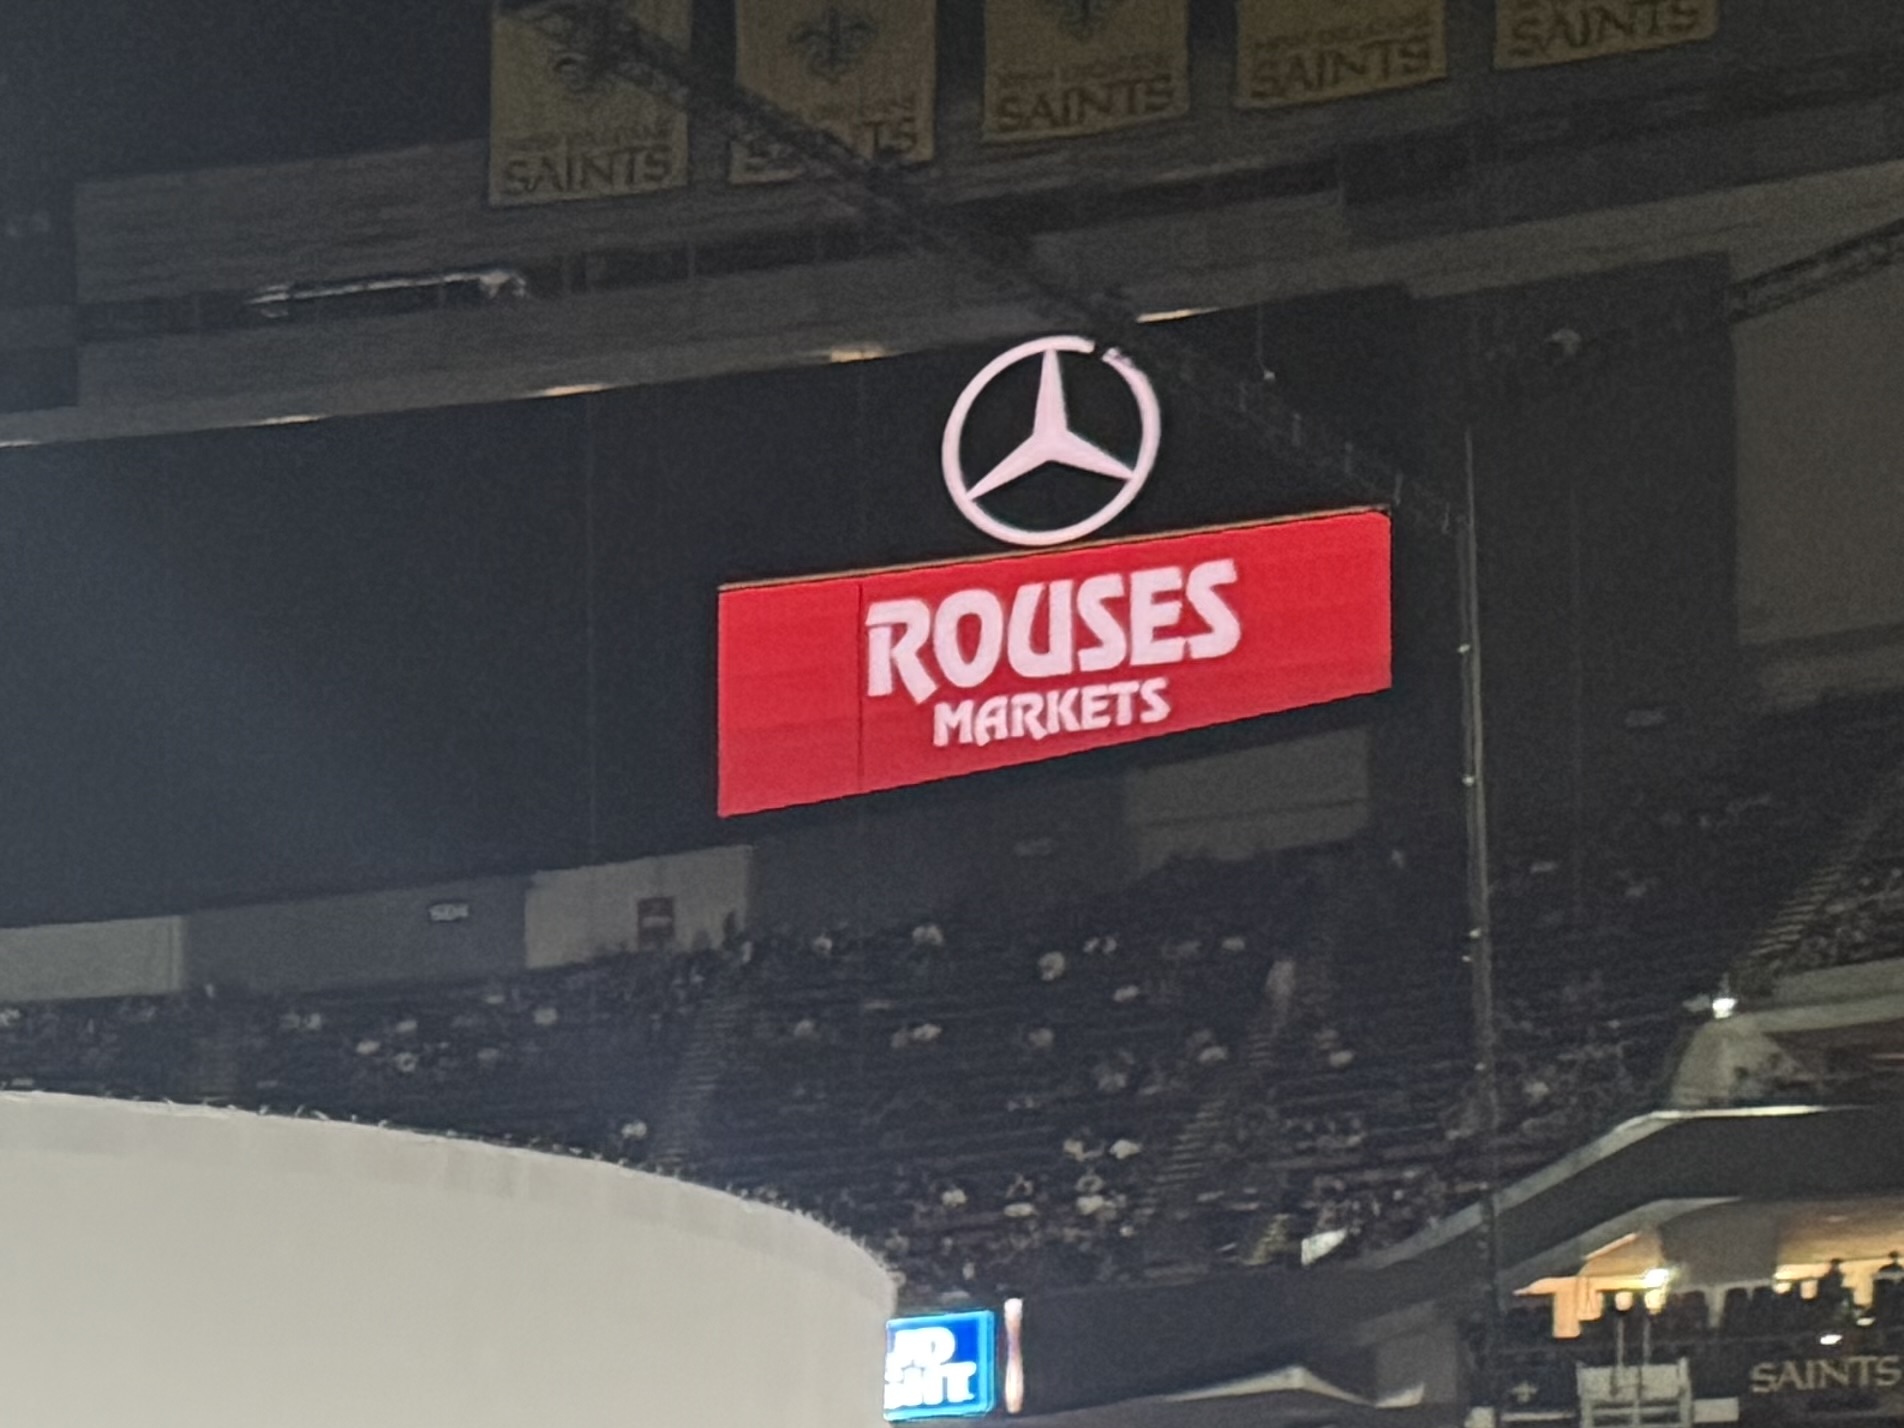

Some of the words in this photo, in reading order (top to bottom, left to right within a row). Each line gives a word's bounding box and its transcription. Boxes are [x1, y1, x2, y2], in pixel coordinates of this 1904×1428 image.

[1249, 38, 1430, 99] SAINTS
[996, 73, 1174, 131] SAINTS
[503, 144, 672, 195] SAINTS
[865, 558, 1242, 703] ROUSES
[933, 677, 1171, 746] MARKETS
[1750, 1354, 1903, 1393] SAINTS
